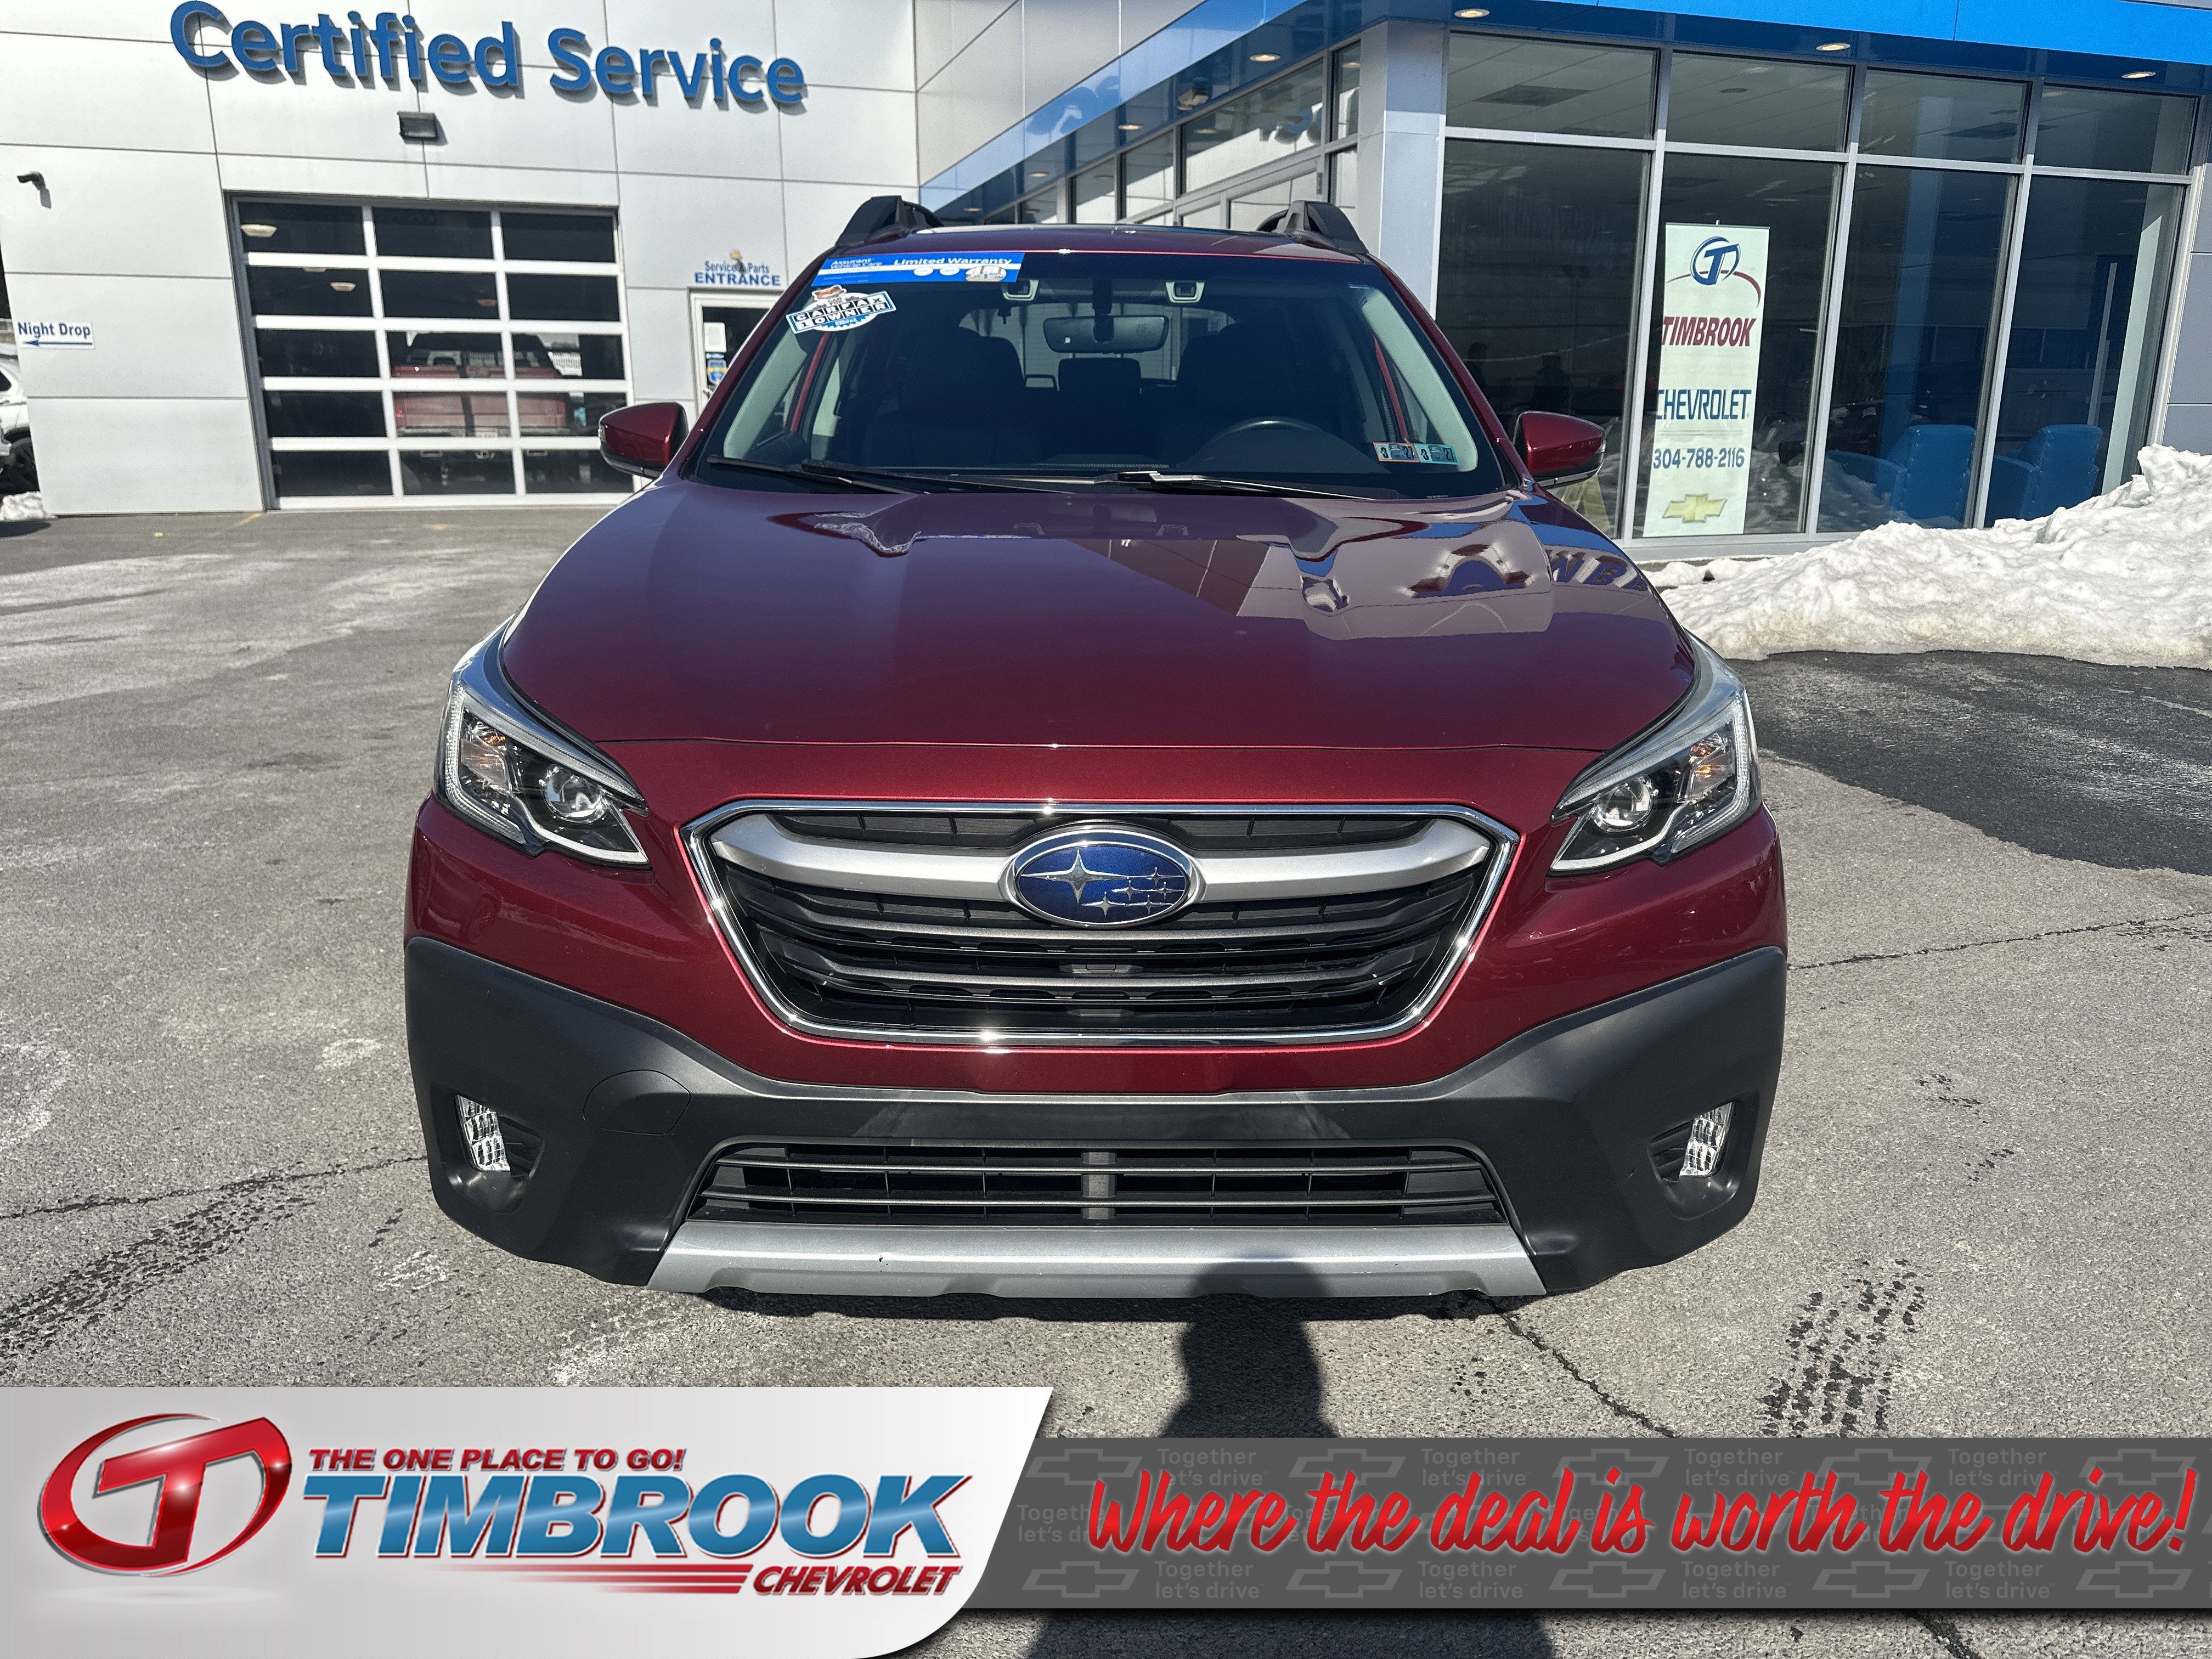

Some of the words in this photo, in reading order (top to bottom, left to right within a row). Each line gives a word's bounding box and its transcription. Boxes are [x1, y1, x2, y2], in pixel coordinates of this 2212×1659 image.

[170, 1, 518, 86] Certified
[548, 28, 804, 103] Service
[704, 260, 736, 272] Service
[748, 262, 770, 274] Parts
[894, 258, 945, 266] Limited
[695, 272, 781, 286] ENTRANCE
[795, 297, 884, 320] CARFAX
[814, 303, 887, 324] OWNER
[18, 321, 54, 338] Night
[59, 323, 91, 338] Drop
[1662, 316, 1758, 347] TIMBROOK
[1656, 389, 1752, 420] CHEVROLET
[1380, 447, 1389, 459] 3
[1420, 448, 1429, 461] 3
[1653, 447, 1745, 469] 304-788-2116
